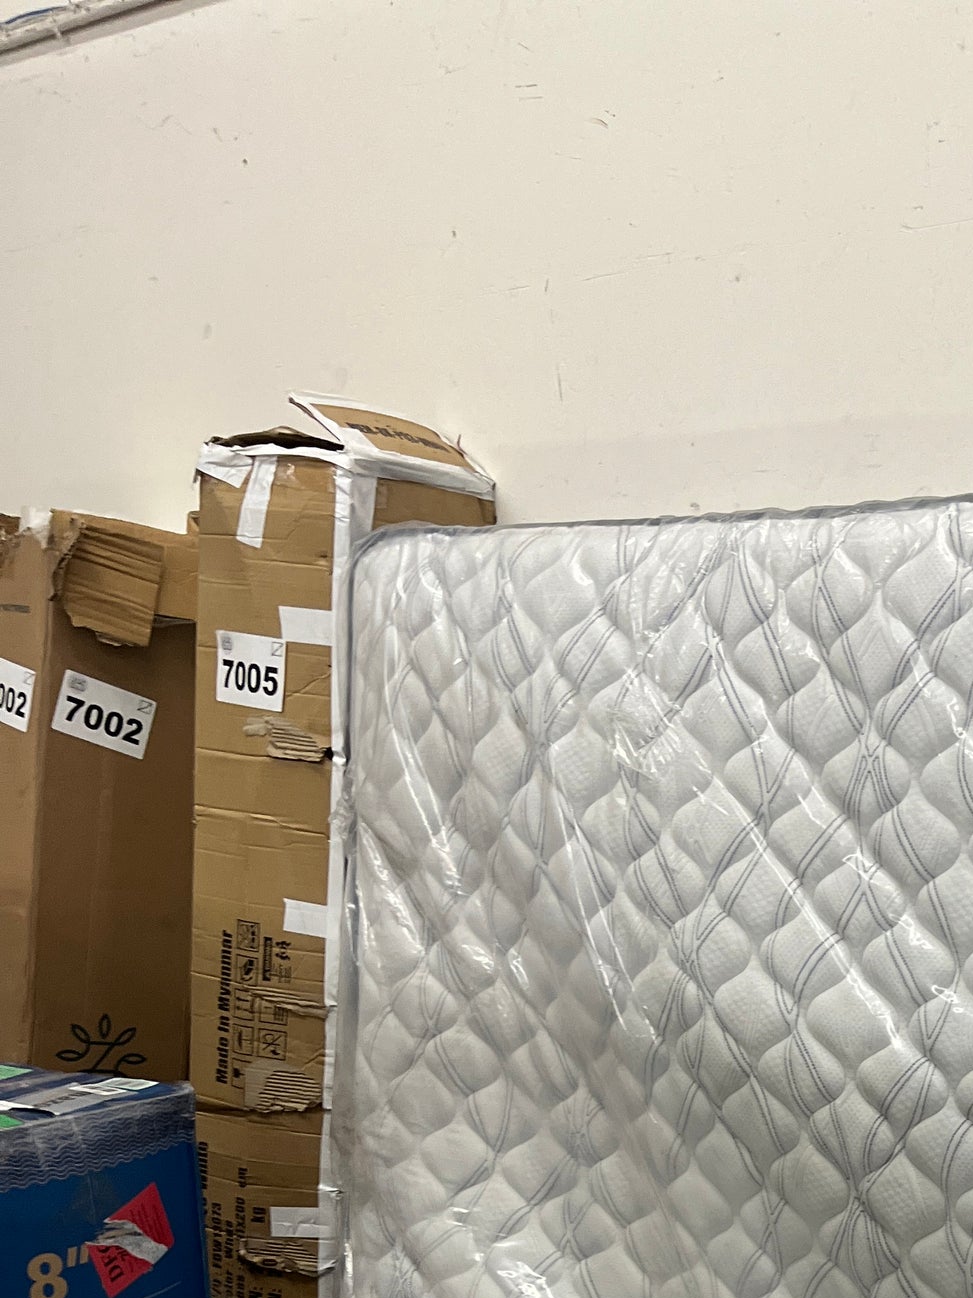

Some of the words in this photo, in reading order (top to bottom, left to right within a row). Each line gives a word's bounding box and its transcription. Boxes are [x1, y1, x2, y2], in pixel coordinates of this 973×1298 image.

[222, 659, 278, 696] 7005
[65, 695, 143, 745] 7002
[218, 930, 232, 1012] Myanmar
[216, 1037, 229, 1084] Made
